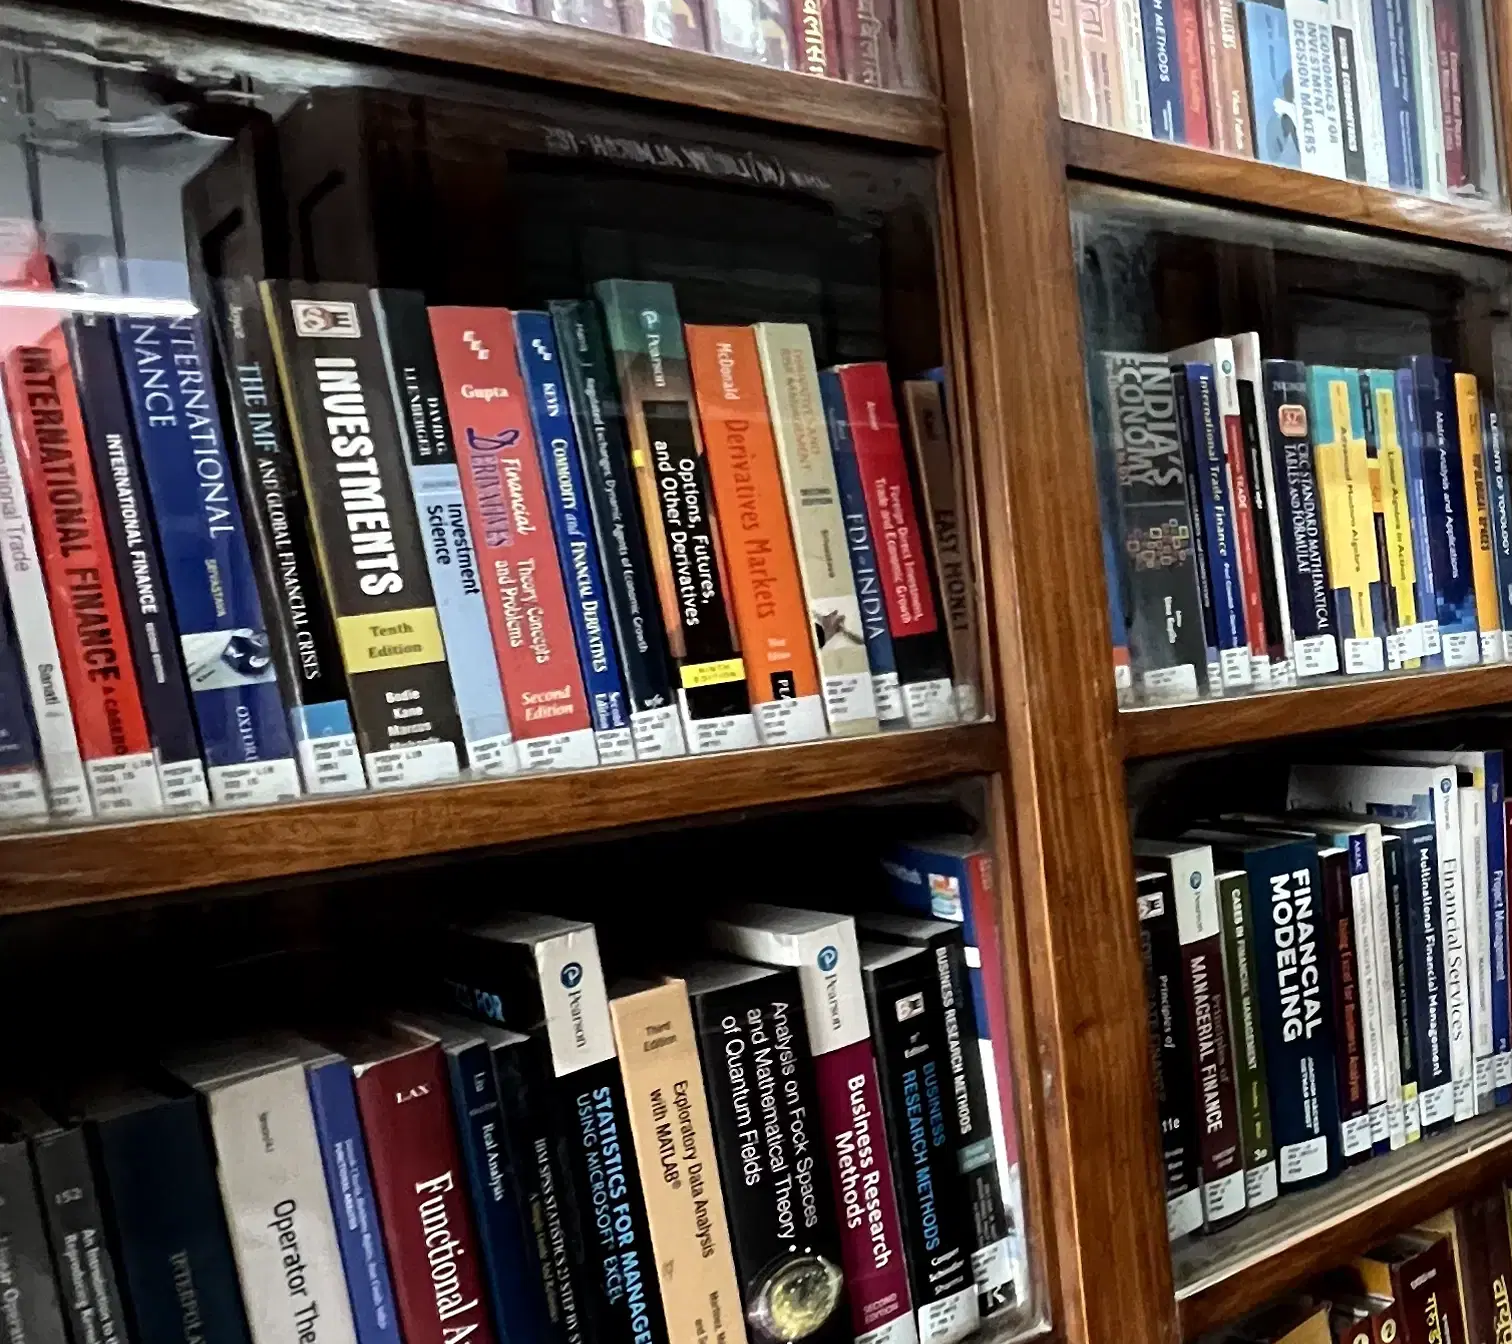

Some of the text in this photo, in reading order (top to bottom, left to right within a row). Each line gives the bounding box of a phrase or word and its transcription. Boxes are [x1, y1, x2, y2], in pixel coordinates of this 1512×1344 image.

[1154, 14, 1169, 83] METHODS
[167, 315, 236, 540] NTERNATIONAL
[461, 385, 510, 400] Gupta
[714, 341, 740, 401] McDonald
[18, 346, 120, 682] INTERNATIONAL FINANCE
[104, 432, 158, 615] INTERNATIONAL FINANCE
[238, 361, 322, 681] THE IMF AND GLOBAL FINANCIAL CRISES
[314, 356, 404, 597] INVESTMENTS
[500, 457, 537, 535] Financial
[654, 440, 700, 626] and Other Derivatives
[678, 457, 720, 604] Options, Futures,
[723, 419, 776, 620] Derivatives Markets
[1199, 375, 1227, 557] International Trade Finance
[1284, 444, 1311, 576] TABLES FORMULAE
[1436, 411, 1460, 579] Matrix Analysis Applications
[1490, 412, 1502, 468] ELEMENTS
[1497, 490, 1511, 556] TOPOLOGY
[426, 505, 451, 566] Science
[448, 502, 482, 596] Investment
[495, 560, 524, 649] and Problems
[571, 540, 597, 601] FINANCIAL
[1300, 470, 1331, 630] STANDARD MATHEMATICAL
[368, 639, 424, 659] Edition
[369, 620, 414, 639] Tenth
[527, 607, 551, 663] Concepts
[580, 596, 609, 672] DERIVATIVES
[855, 569, 883, 642] INDIA
[520, 685, 573, 708] Second
[524, 700, 574, 722] Edition
[1270, 874, 1304, 1043] MODELING
[1291, 868, 1324, 1039] FINANCIAL
[1419, 847, 1444, 1076] Multinational Financial Management
[1443, 856, 1466, 1044] Financial Services
[1493, 870, 1506, 982] Project Management
[566, 990, 588, 1048] Pearson
[821, 971, 843, 1031] Pearson
[936, 946, 974, 1134] BUSINESS RESEARCH METHODS
[1158, 975, 1173, 1030] Principles
[1190, 956, 1224, 1133] MANAGERIAL FINANCE
[395, 1082, 430, 1104] LAX
[481, 1121, 505, 1201] Real Analysis
[651, 1088, 670, 1127] with
[725, 1038, 762, 1187] Quantum Fields
[747, 1009, 798, 1239] and Mathematical Theory
[770, 1001, 818, 1229] Analysis Fock Spaces
[903, 1069, 942, 1252] RESEARCH METHODS
[923, 1061, 946, 1148] BUSINESS
[1161, 1118, 1180, 1132] 11e
[576, 1093, 599, 1149] USING
[604, 1253, 624, 1305] EXCEL
[591, 1086, 625, 1202] STATISTICS
[611, 1200, 633, 1247] FOR
[672, 1079, 715, 1260] Exploratory Data Analysis
[835, 1129, 863, 1230] Methods
[846, 1073, 892, 1270] Business Research
[271, 1197, 309, 1303] Operator
[415, 1170, 479, 1322] Functional
